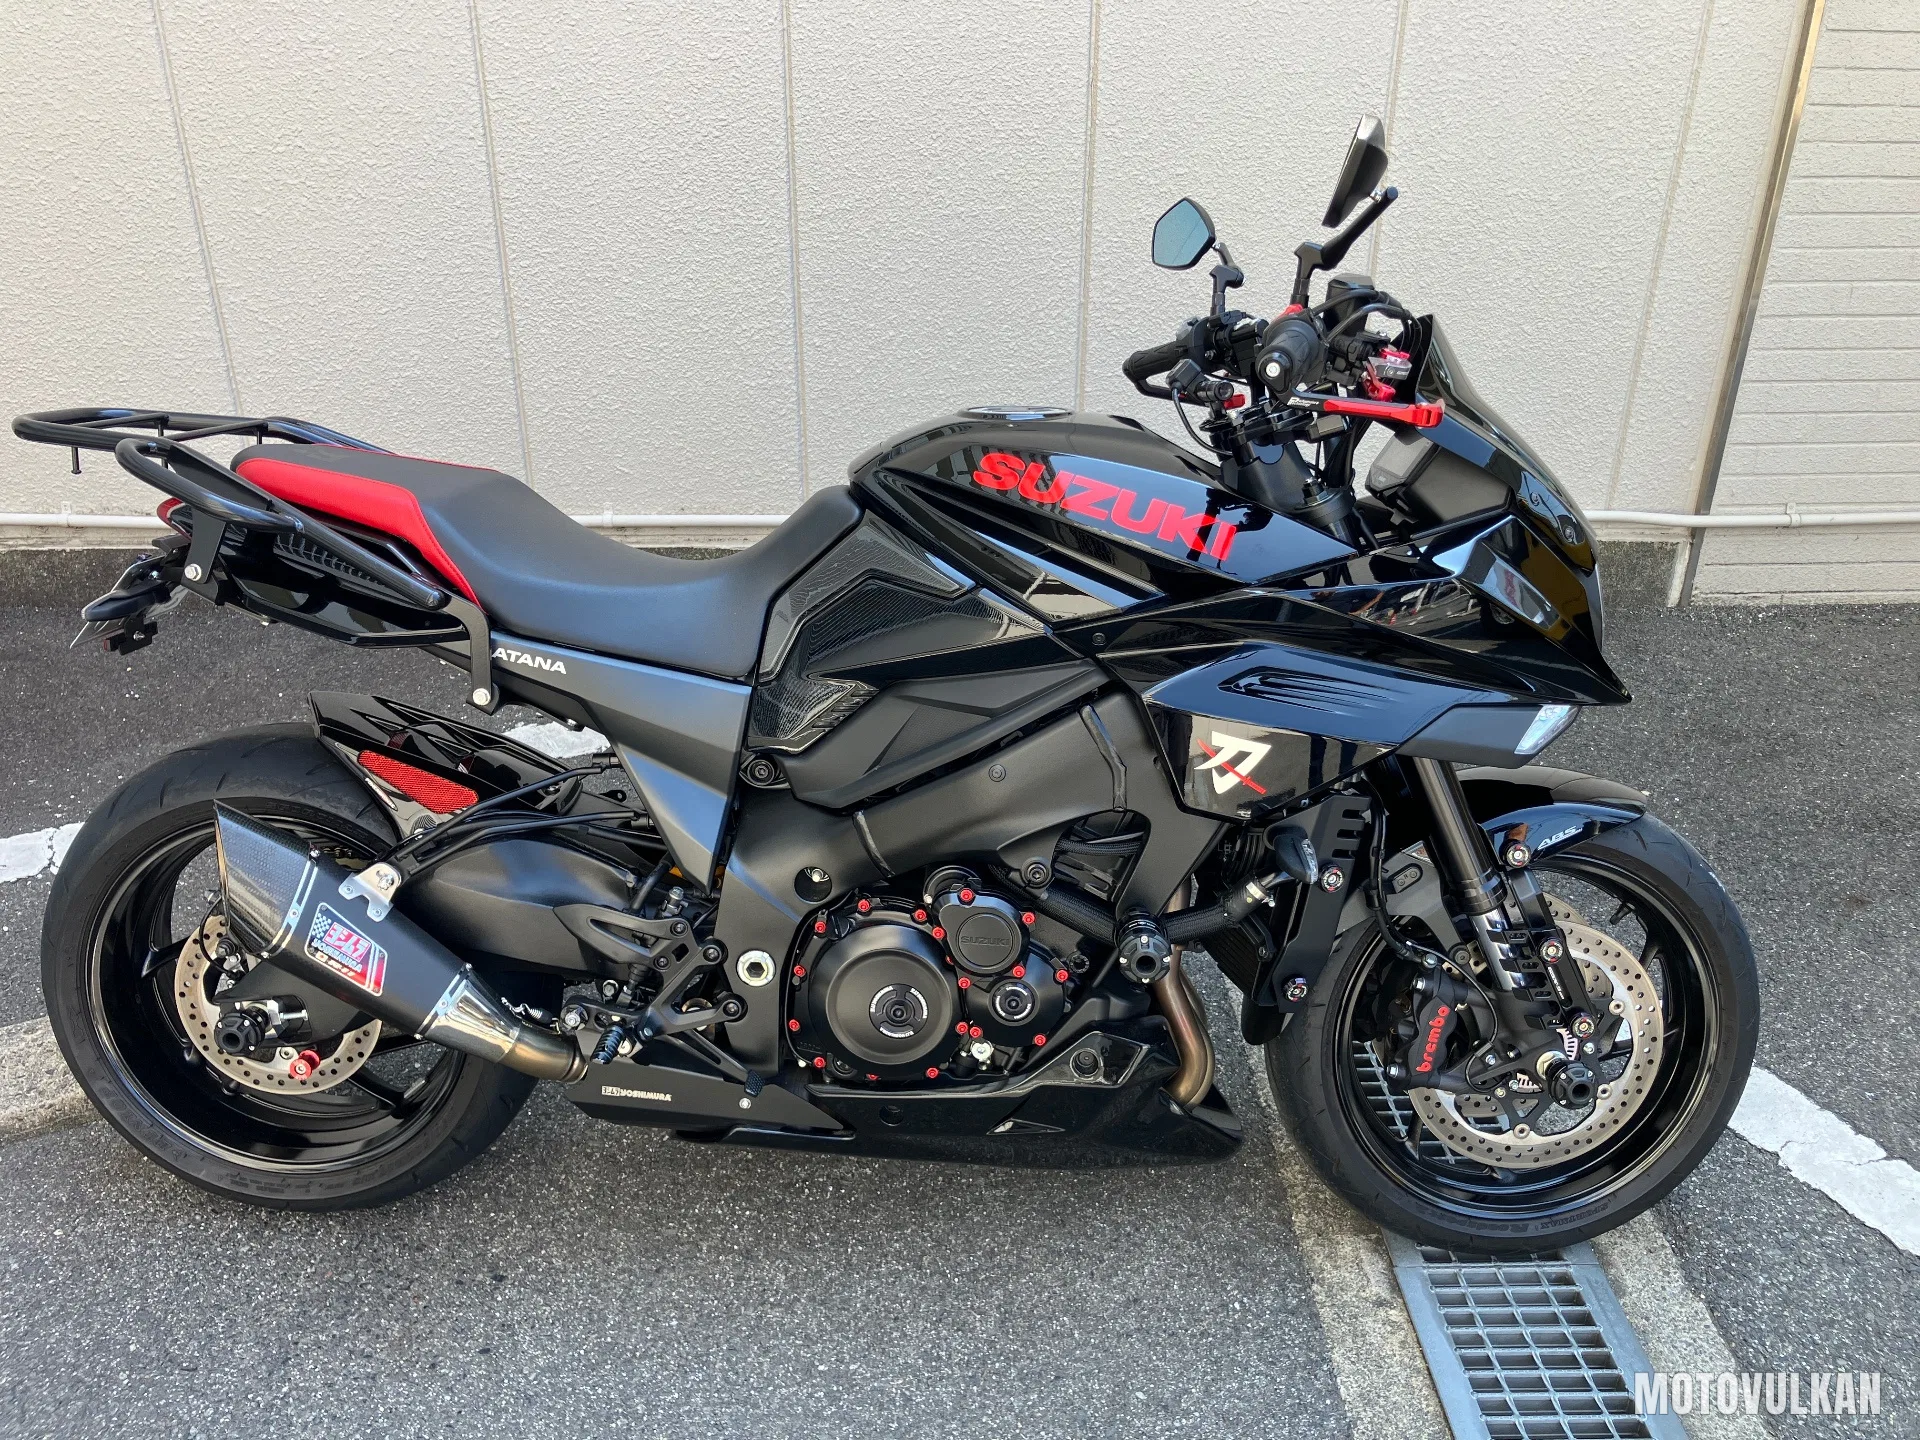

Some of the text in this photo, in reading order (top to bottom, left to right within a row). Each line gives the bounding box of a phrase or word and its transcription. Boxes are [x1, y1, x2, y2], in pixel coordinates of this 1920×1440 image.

[973, 453, 1237, 561] SUZUKI
[490, 647, 567, 674] ATANA
[1538, 826, 1577, 850] ABS
[960, 935, 1010, 947] SUZUKI
[1416, 1005, 1450, 1072] brembo
[620, 1088, 672, 1101] YOSHIMURA
